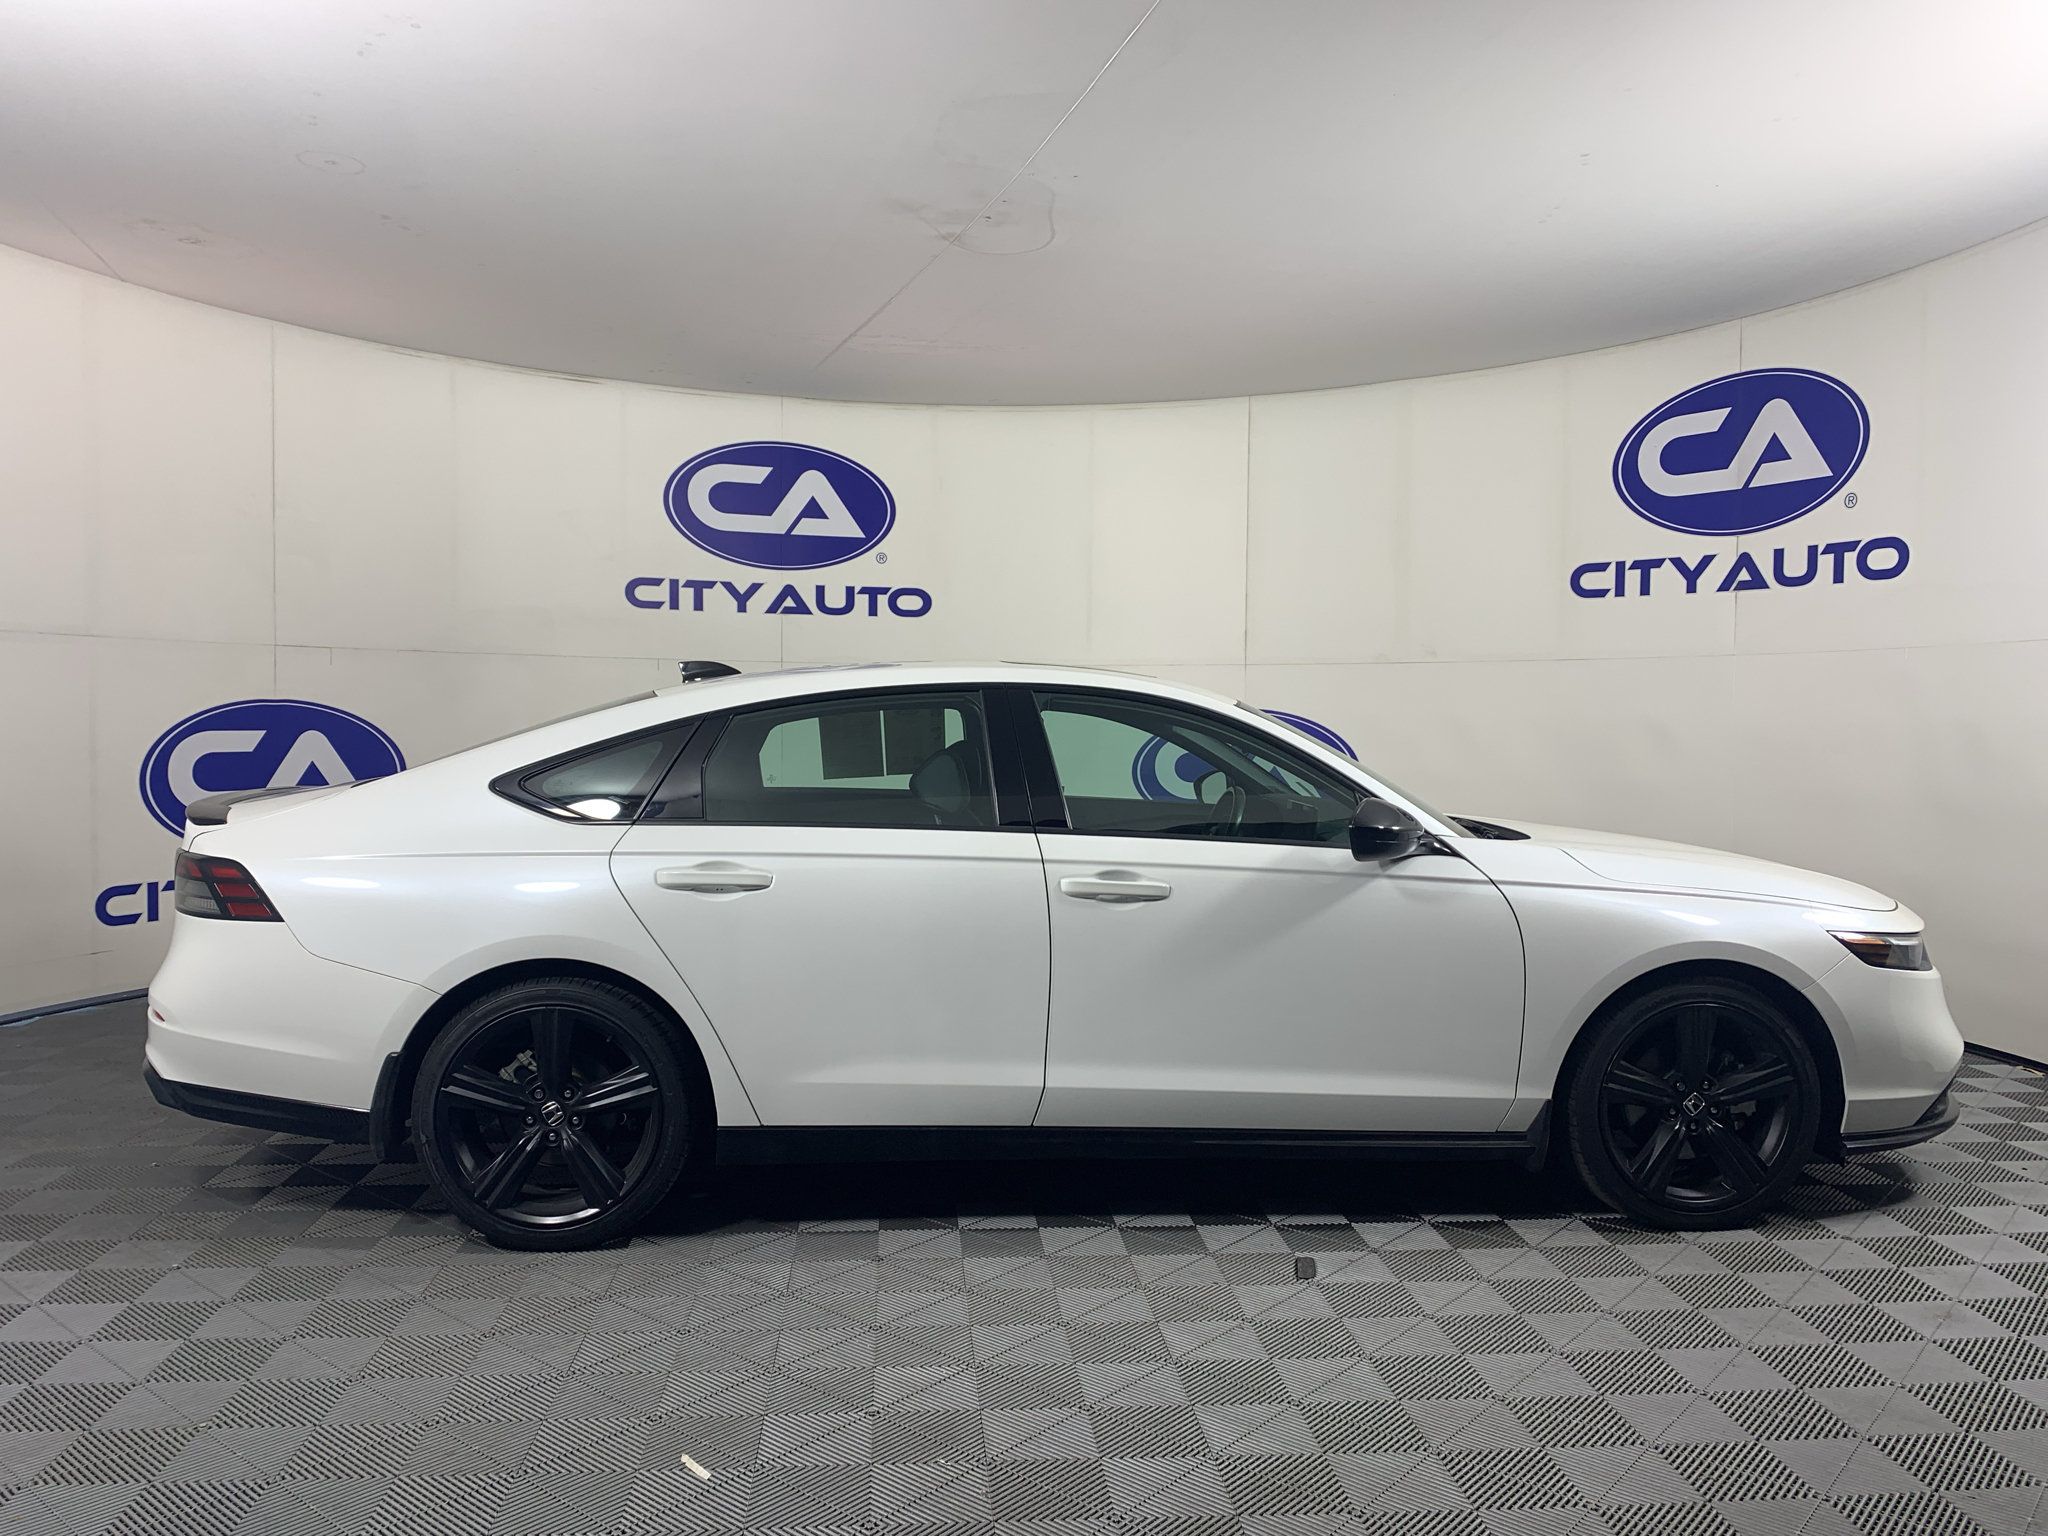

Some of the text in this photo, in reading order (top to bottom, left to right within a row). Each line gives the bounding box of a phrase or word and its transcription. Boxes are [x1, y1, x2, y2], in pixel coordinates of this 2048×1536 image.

[1638, 398, 1834, 497] CA
[687, 463, 866, 538] CA
[625, 577, 933, 617] CITY AUTO
[1570, 537, 1910, 598] CITY AUTO
[95, 881, 175, 926] CI
